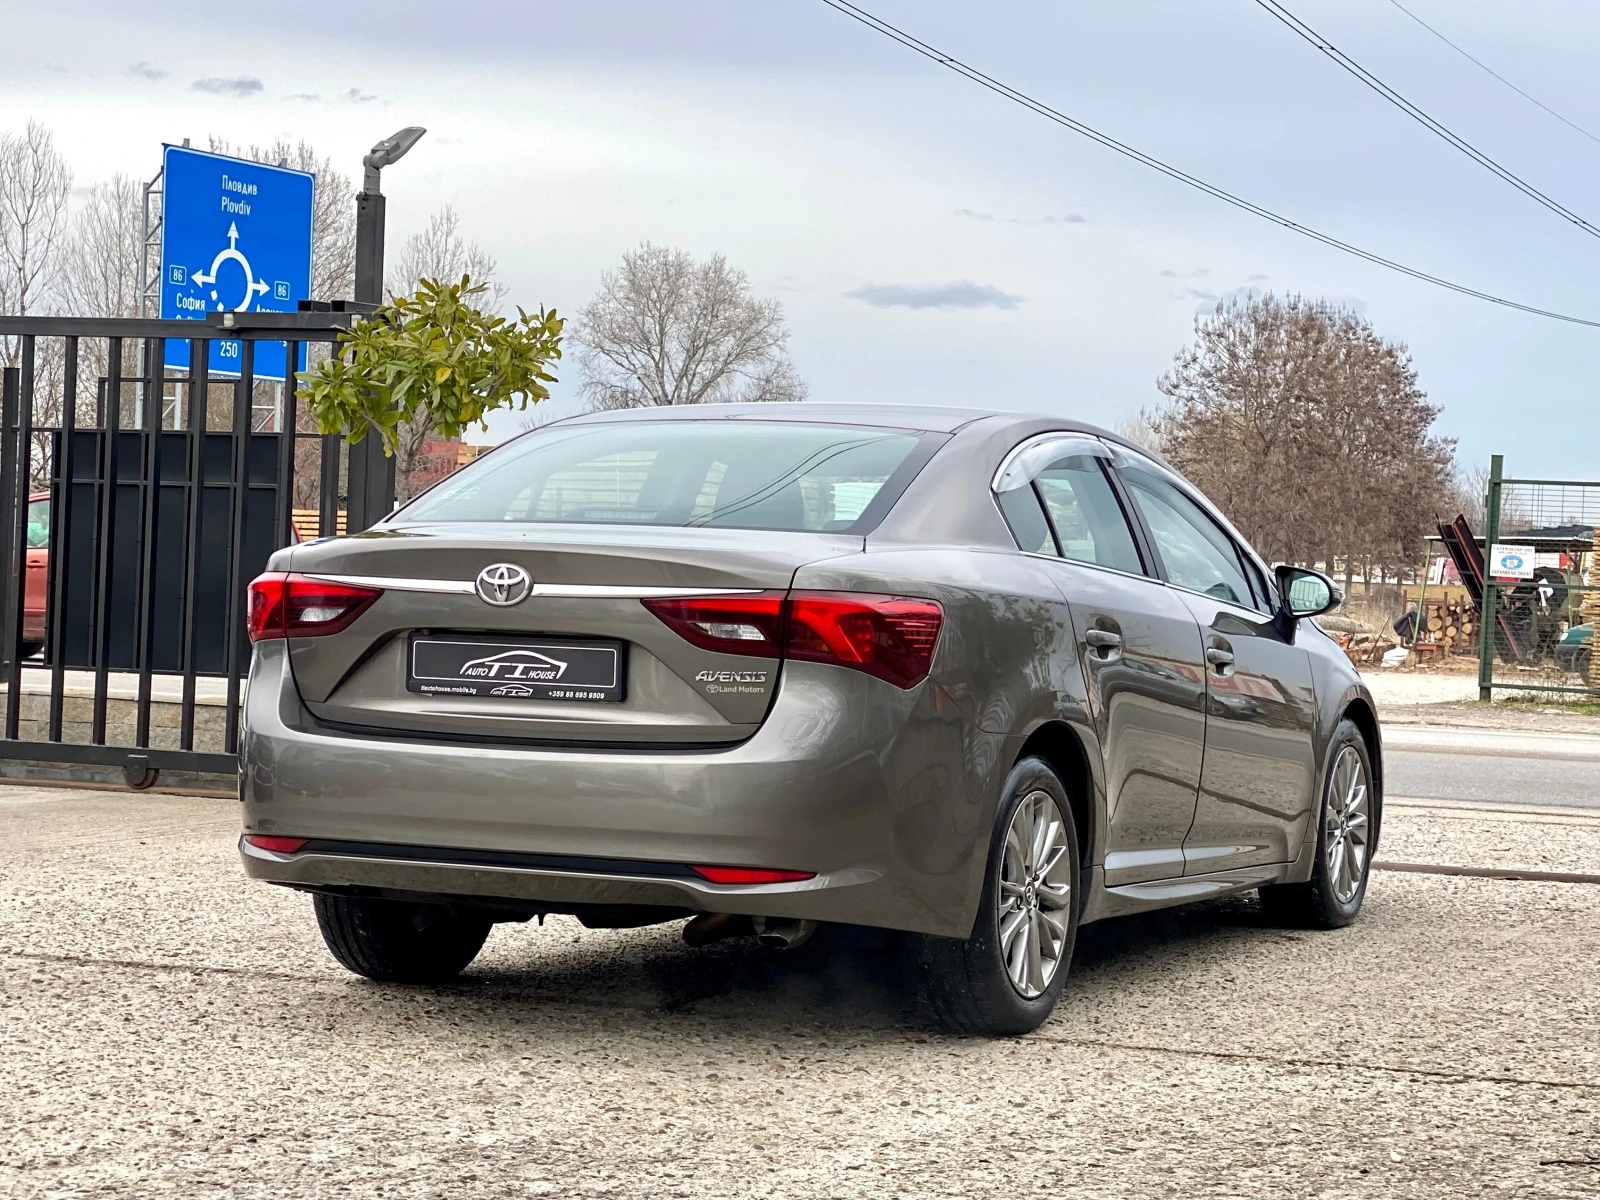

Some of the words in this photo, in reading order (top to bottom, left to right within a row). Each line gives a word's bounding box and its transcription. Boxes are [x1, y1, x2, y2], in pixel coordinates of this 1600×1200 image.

[222, 175, 258, 196] Пловдив
[221, 197, 251, 216] Plovdiv
[173, 268, 183, 282] 86
[277, 285, 287, 298] 86
[176, 293, 206, 312] София
[220, 341, 238, 358] 250
[465, 667, 488, 677] AUTO
[528, 670, 557, 680] HOUSE
[695, 670, 767, 682] AVENSIS
[548, 690, 564, 698] +359
[588, 692, 605, 700] 9509
[719, 685, 737, 693] Land
